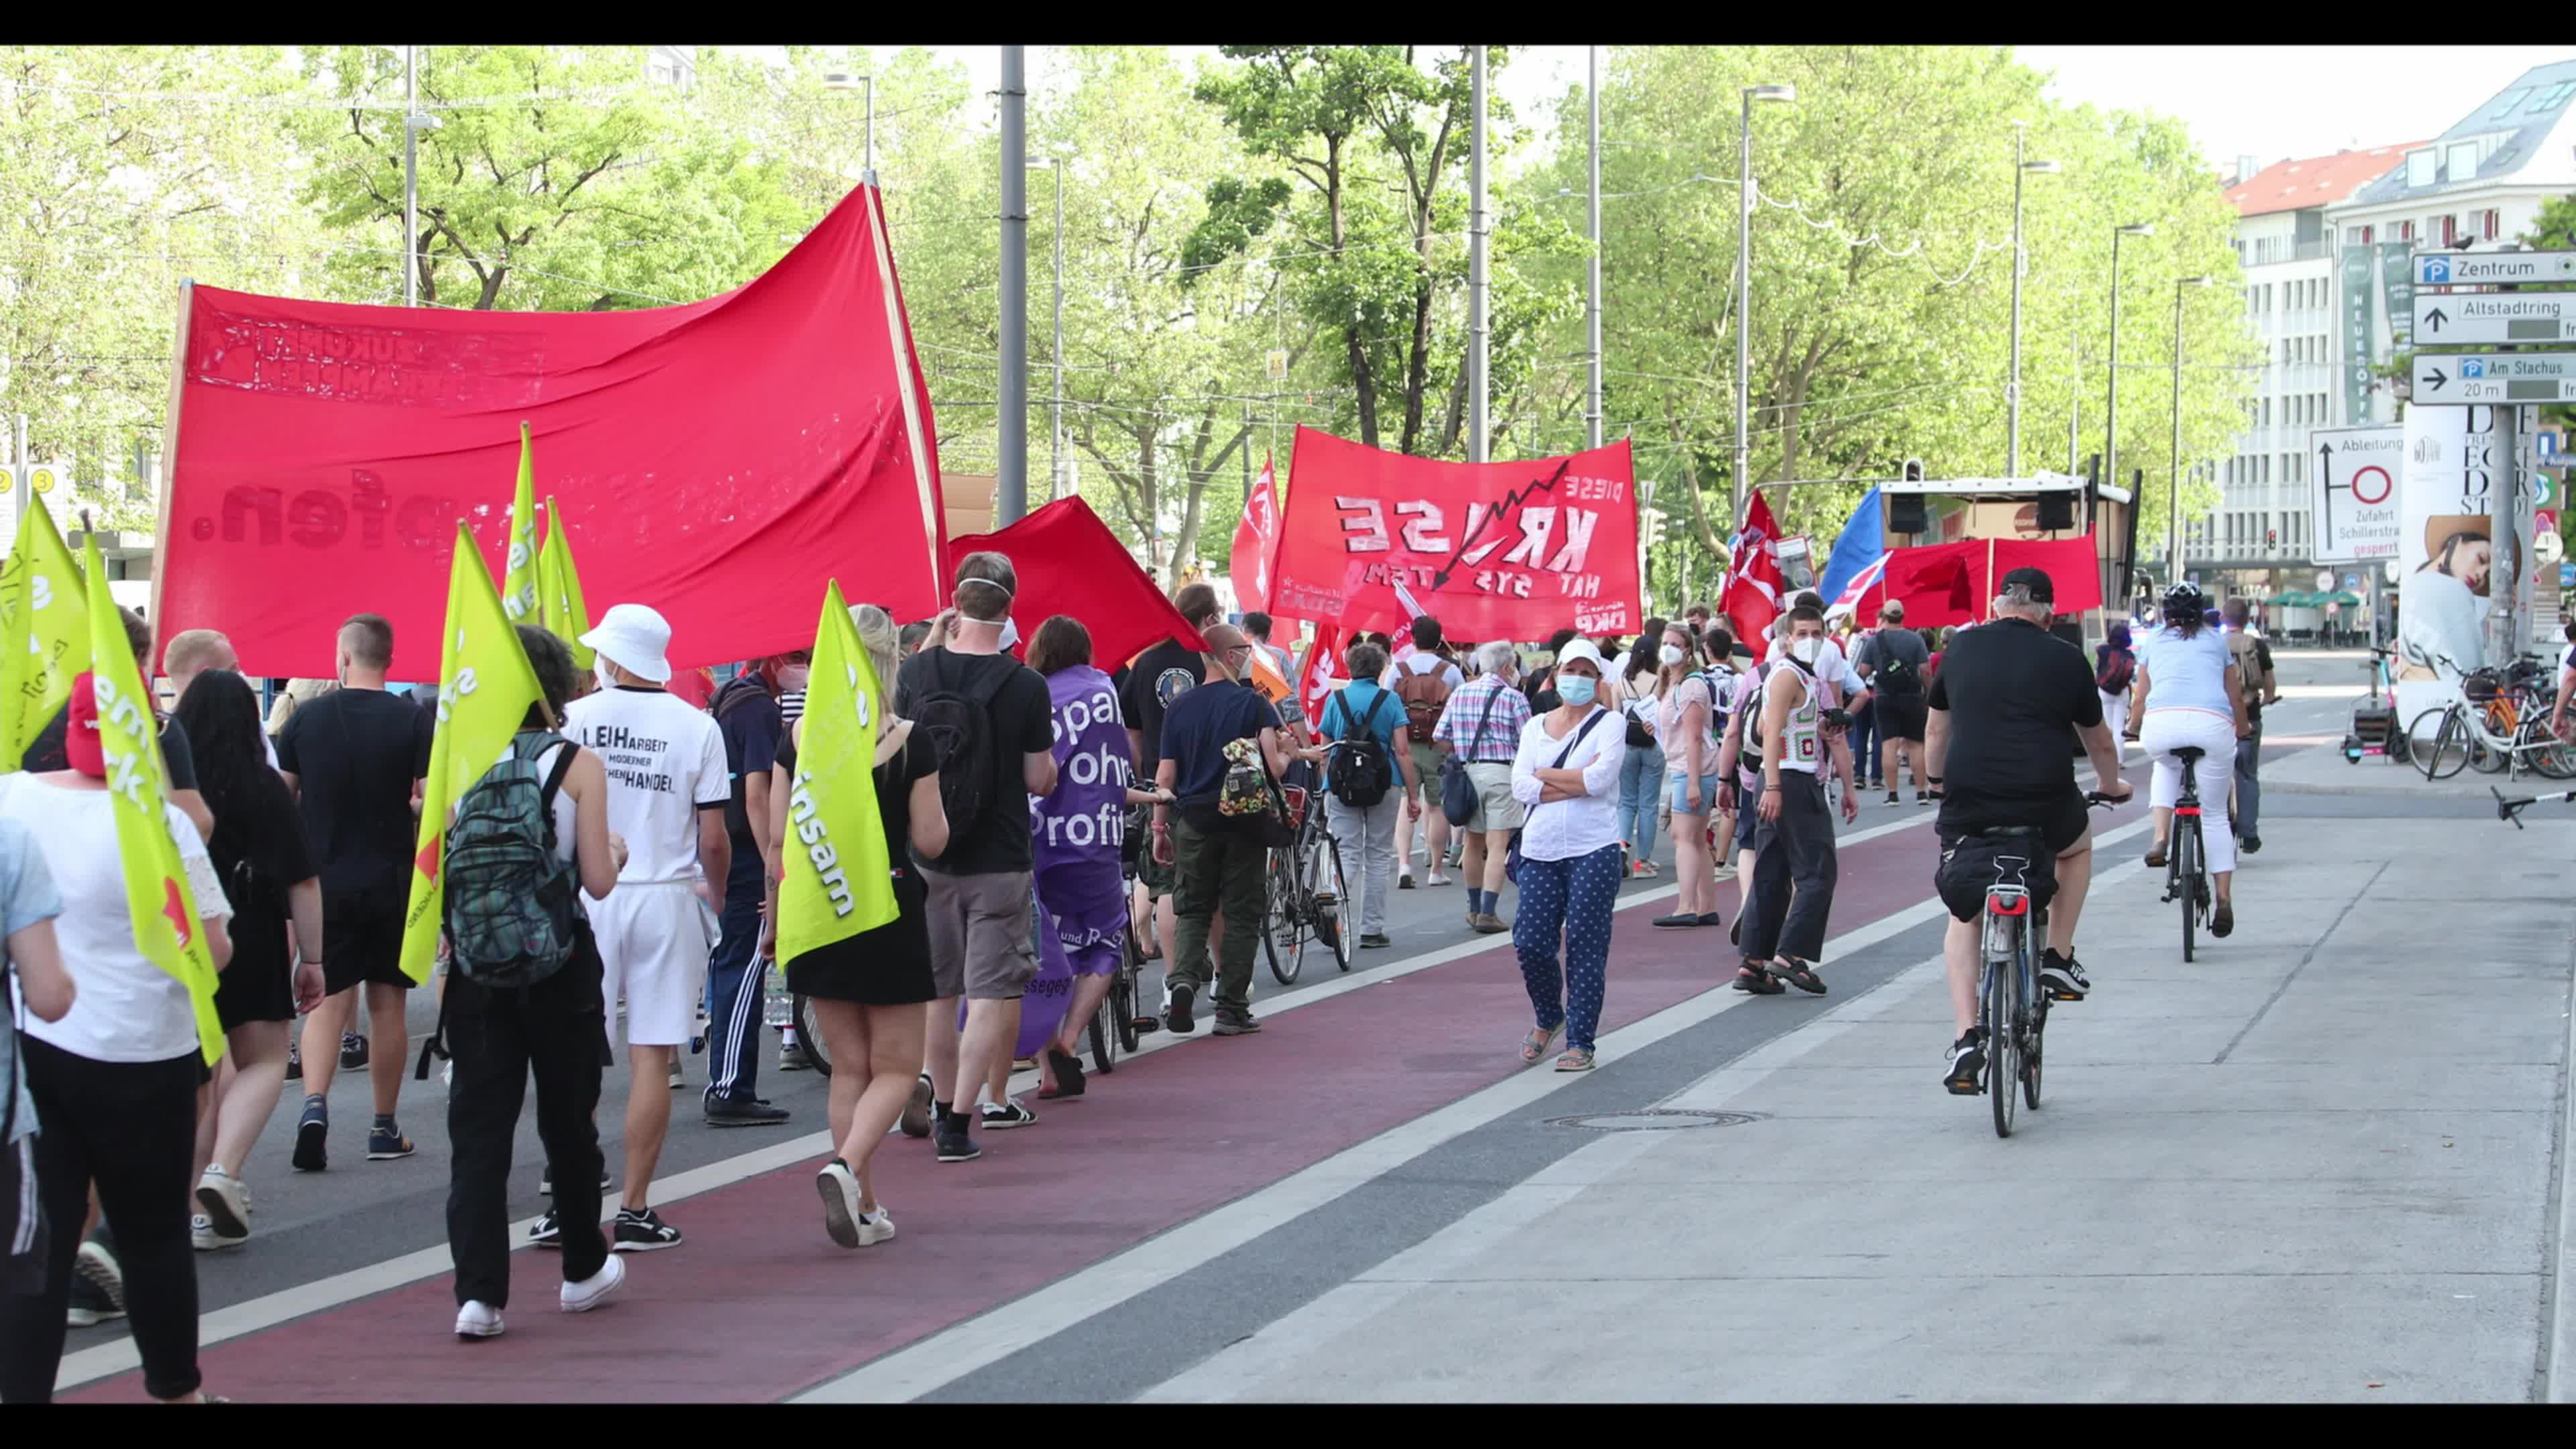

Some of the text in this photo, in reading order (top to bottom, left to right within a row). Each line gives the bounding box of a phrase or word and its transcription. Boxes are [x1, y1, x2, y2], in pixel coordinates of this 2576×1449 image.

[2458, 261, 2535, 276] Zentrum
[2463, 302, 2561, 317] Altstadtring
[2489, 362, 2509, 375] Am
[2516, 360, 2563, 374] Stachus
[2464, 384, 2481, 396] 20
[2485, 386, 2499, 395] m
[2355, 509, 2394, 523] Zufahrt
[608, 753, 653, 767] MODERNER
